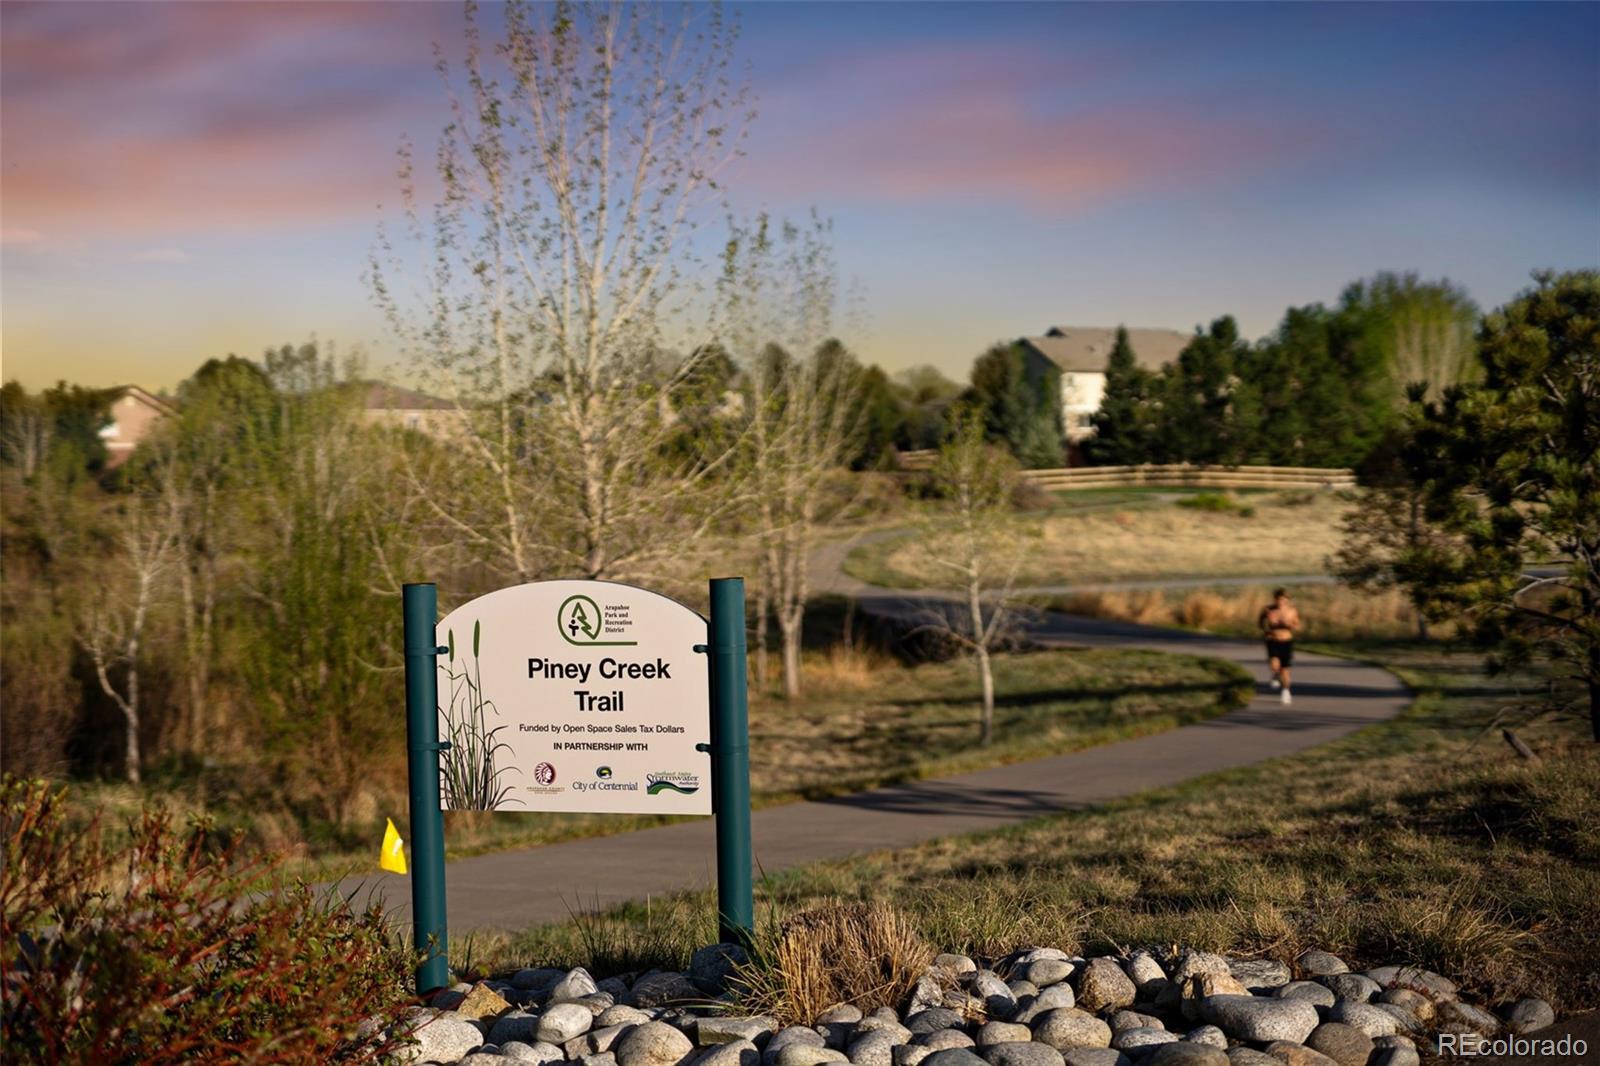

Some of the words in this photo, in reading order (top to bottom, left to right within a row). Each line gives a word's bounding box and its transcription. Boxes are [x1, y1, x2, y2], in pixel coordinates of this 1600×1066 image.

[528, 658, 592, 683] Piney
[599, 658, 672, 679] Creek
[574, 691, 624, 712] Trail
[519, 724, 549, 732] Funded
[551, 724, 562, 734] by
[563, 724, 585, 734] Open
[587, 725, 613, 734] Space
[614, 725, 637, 733] Sales
[640, 725, 654, 733] Tax
[656, 725, 685, 733] Dollars
[553, 742, 563, 750] IN
[564, 742, 624, 751] PARTNERSHIP
[626, 743, 648, 751] WITH
[572, 781, 588, 792] City
[589, 781, 597, 790] of
[598, 782, 638, 791] Centennial
